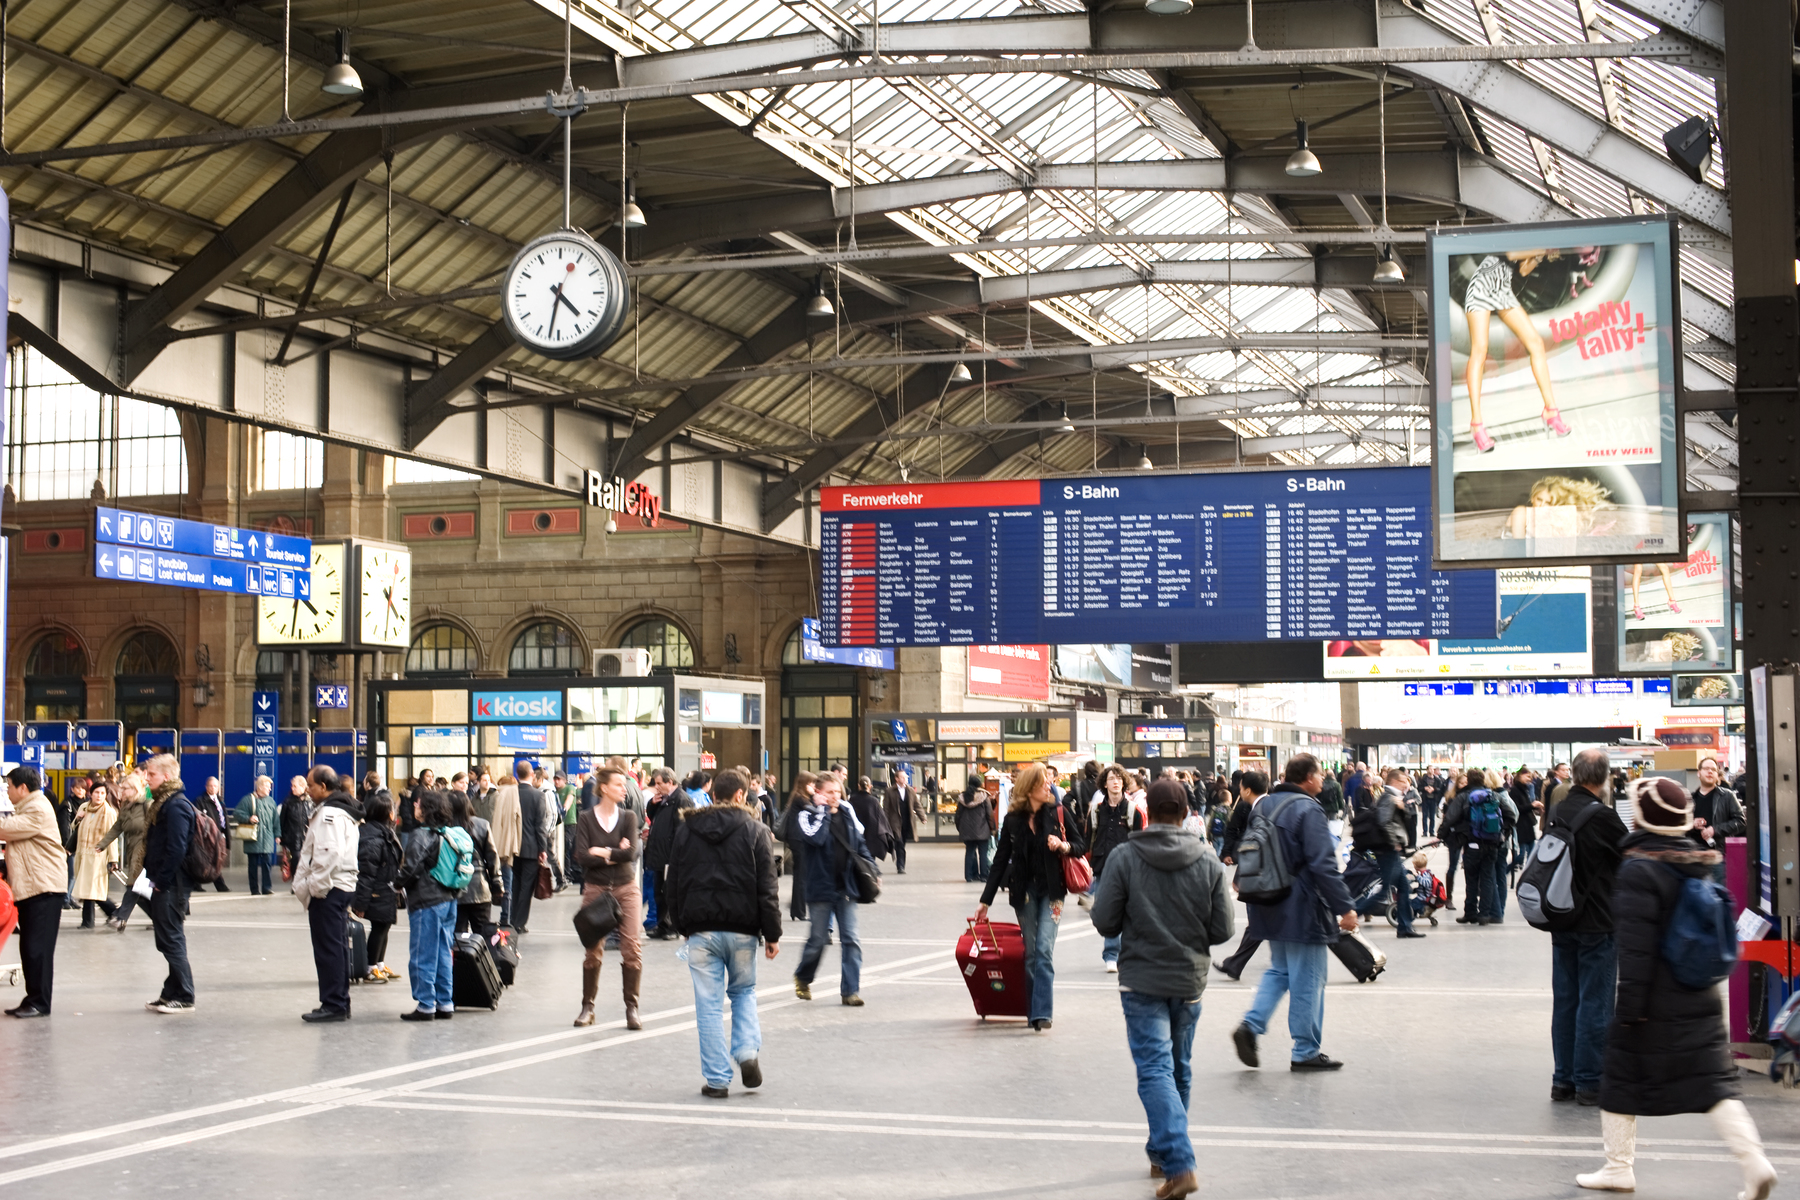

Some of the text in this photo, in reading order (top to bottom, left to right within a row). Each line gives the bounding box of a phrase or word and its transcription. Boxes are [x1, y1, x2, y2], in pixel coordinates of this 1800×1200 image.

[1548, 300, 1631, 343] totally
[1576, 312, 1645, 361] tally!
[1585, 448, 1618, 458] TALLY
[1063, 484, 1120, 500] S-Bahn
[1286, 477, 1346, 492] S-Bahn
[586, 468, 661, 528] RailCity
[842, 491, 923, 506] Fernverkehr
[265, 548, 306, 563] Tourist Service
[158, 557, 188, 571] Fundbüro
[1684, 555, 1718, 579] tally!
[158, 568, 204, 584] Lost and found
[213, 575, 232, 587] Polizei
[264, 580, 277, 592] WC
[477, 696, 557, 716] k kiosk
[256, 745, 273, 754] WC
